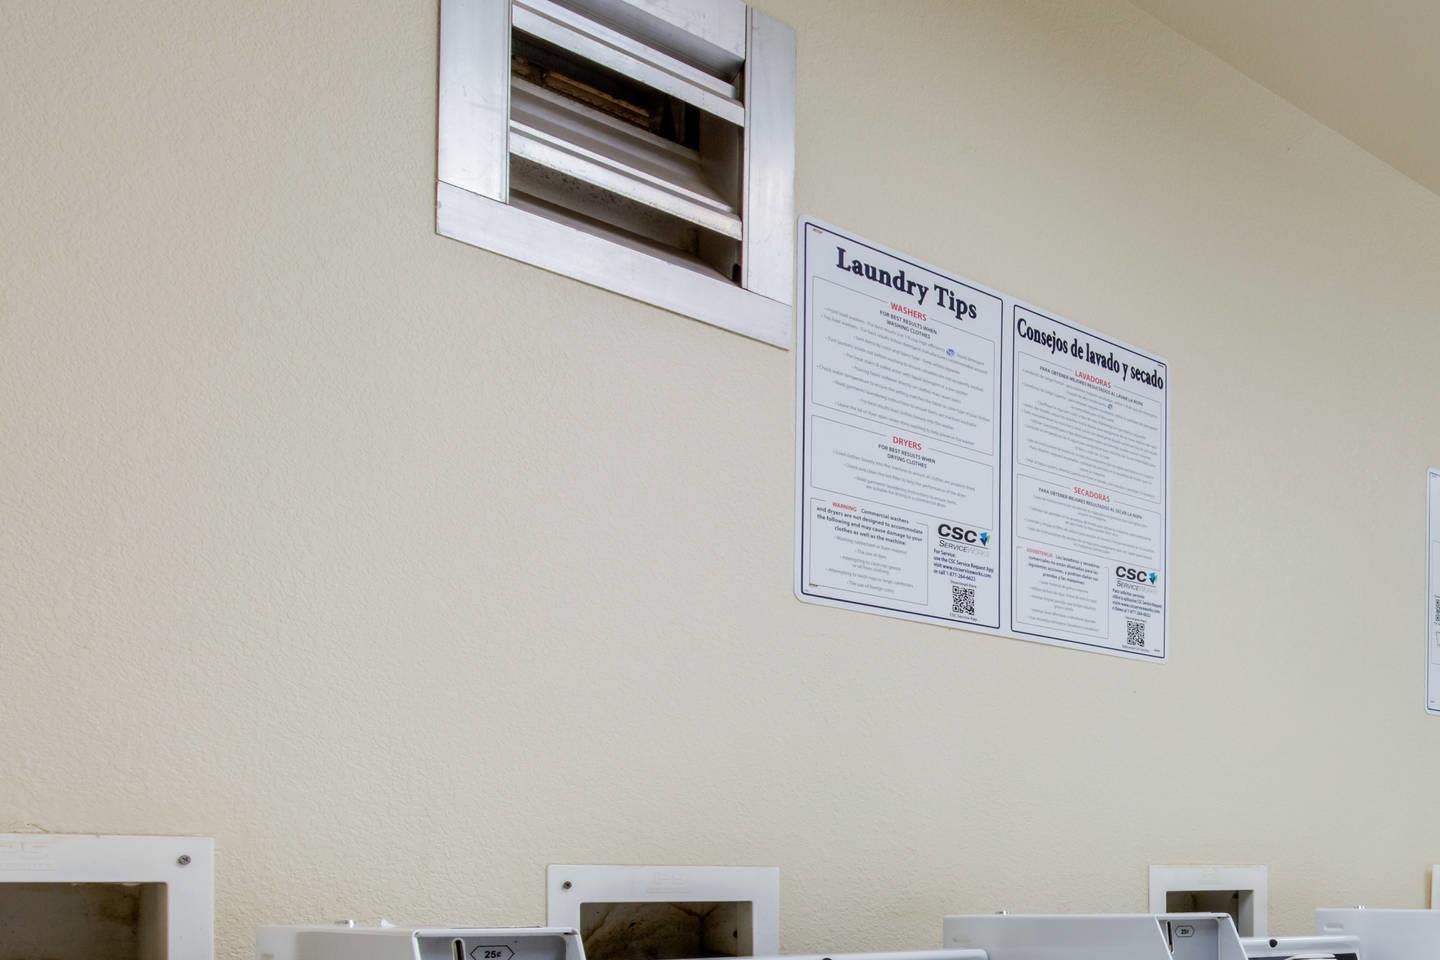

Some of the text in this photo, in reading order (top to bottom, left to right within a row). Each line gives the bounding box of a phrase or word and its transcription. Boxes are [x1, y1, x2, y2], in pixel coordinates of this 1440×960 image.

[837, 247, 976, 320] Laundry Tips
[891, 303, 926, 321] WASHERS
[1017, 318, 1163, 389] Consejos de lavado y secado
[1075, 371, 1111, 388] LAVADORAS
[893, 436, 922, 450] DRYERS
[901, 450, 921, 460] RESULTS
[1074, 487, 1110, 502] SECADORAS
[938, 524, 977, 543] CSC
[1116, 566, 1147, 582] CSC
